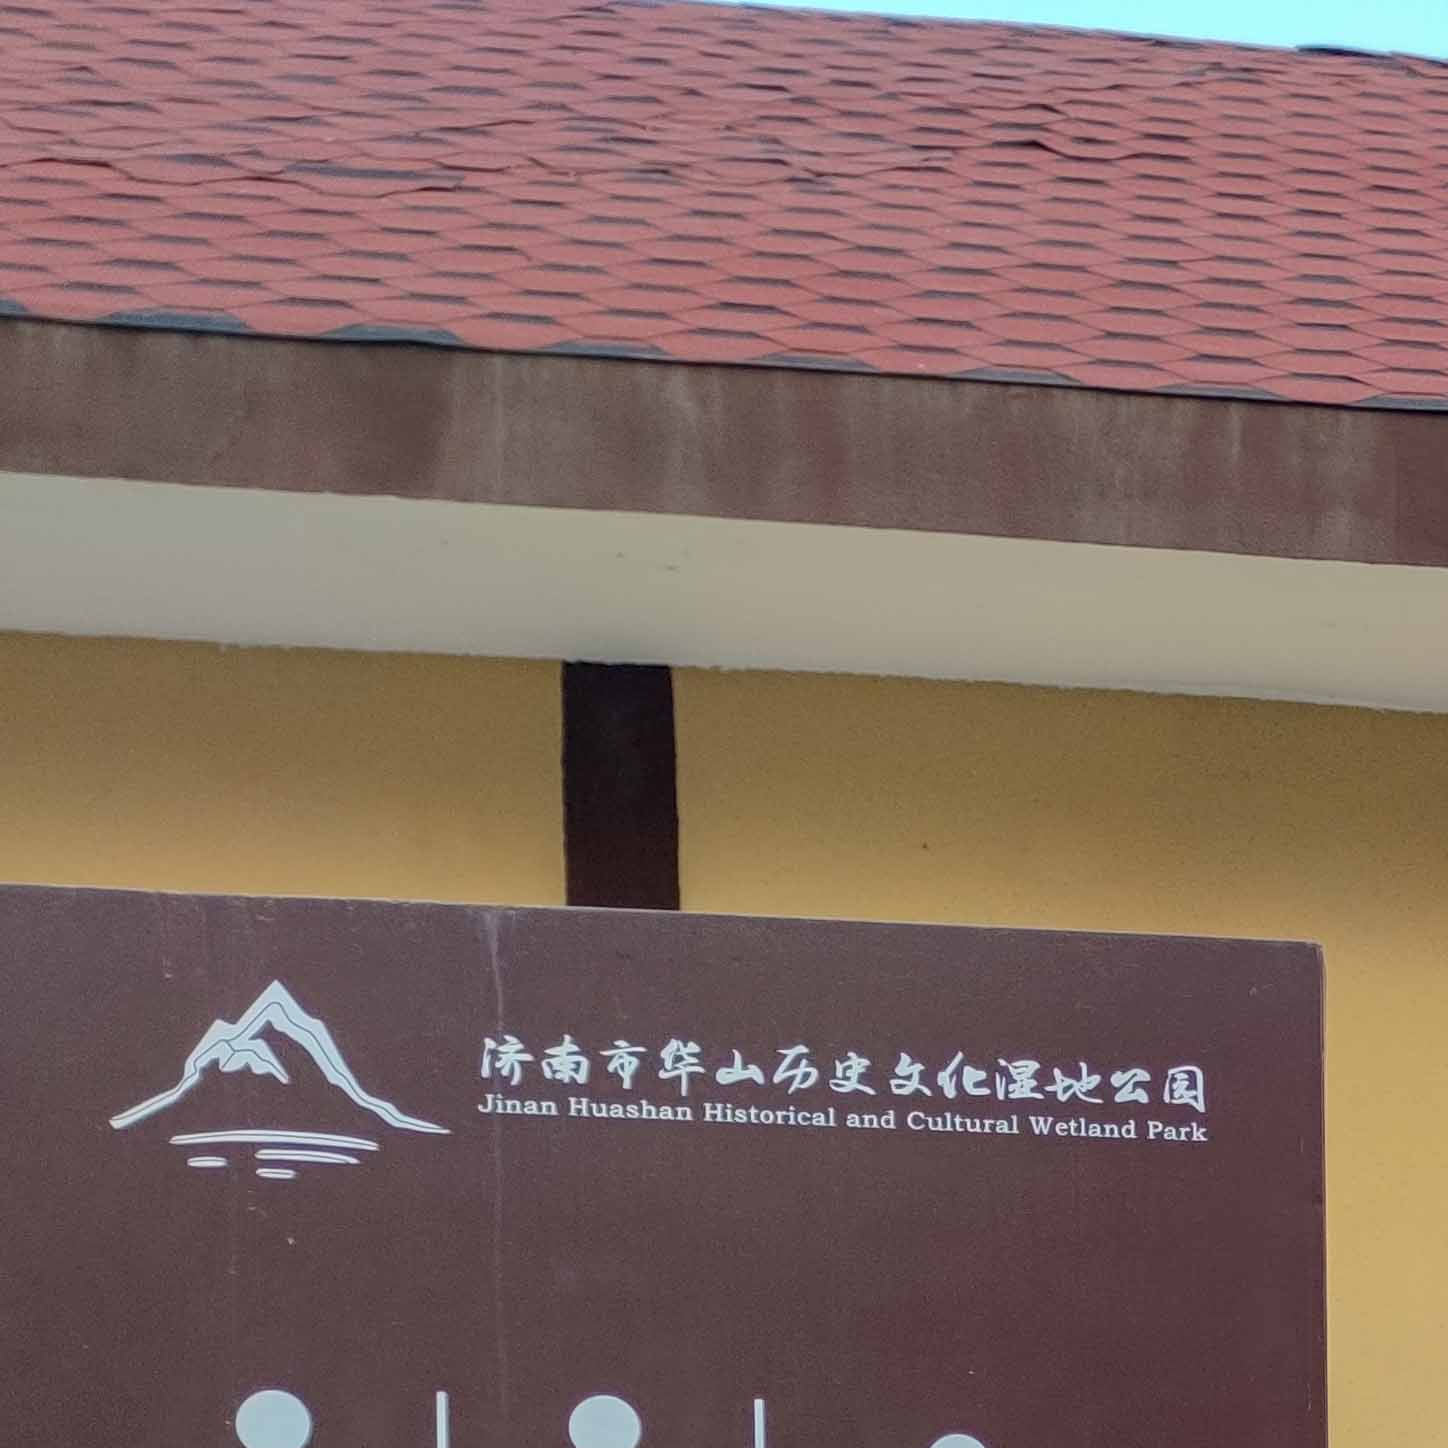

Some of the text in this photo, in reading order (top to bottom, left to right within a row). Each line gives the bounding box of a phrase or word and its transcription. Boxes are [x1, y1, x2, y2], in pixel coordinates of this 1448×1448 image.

[480, 1033, 1206, 1113] 济南市华山历史文化湿地公园
[478, 1094, 1209, 1142] Jinan Huashan Historical and Cultural Wetland Park
